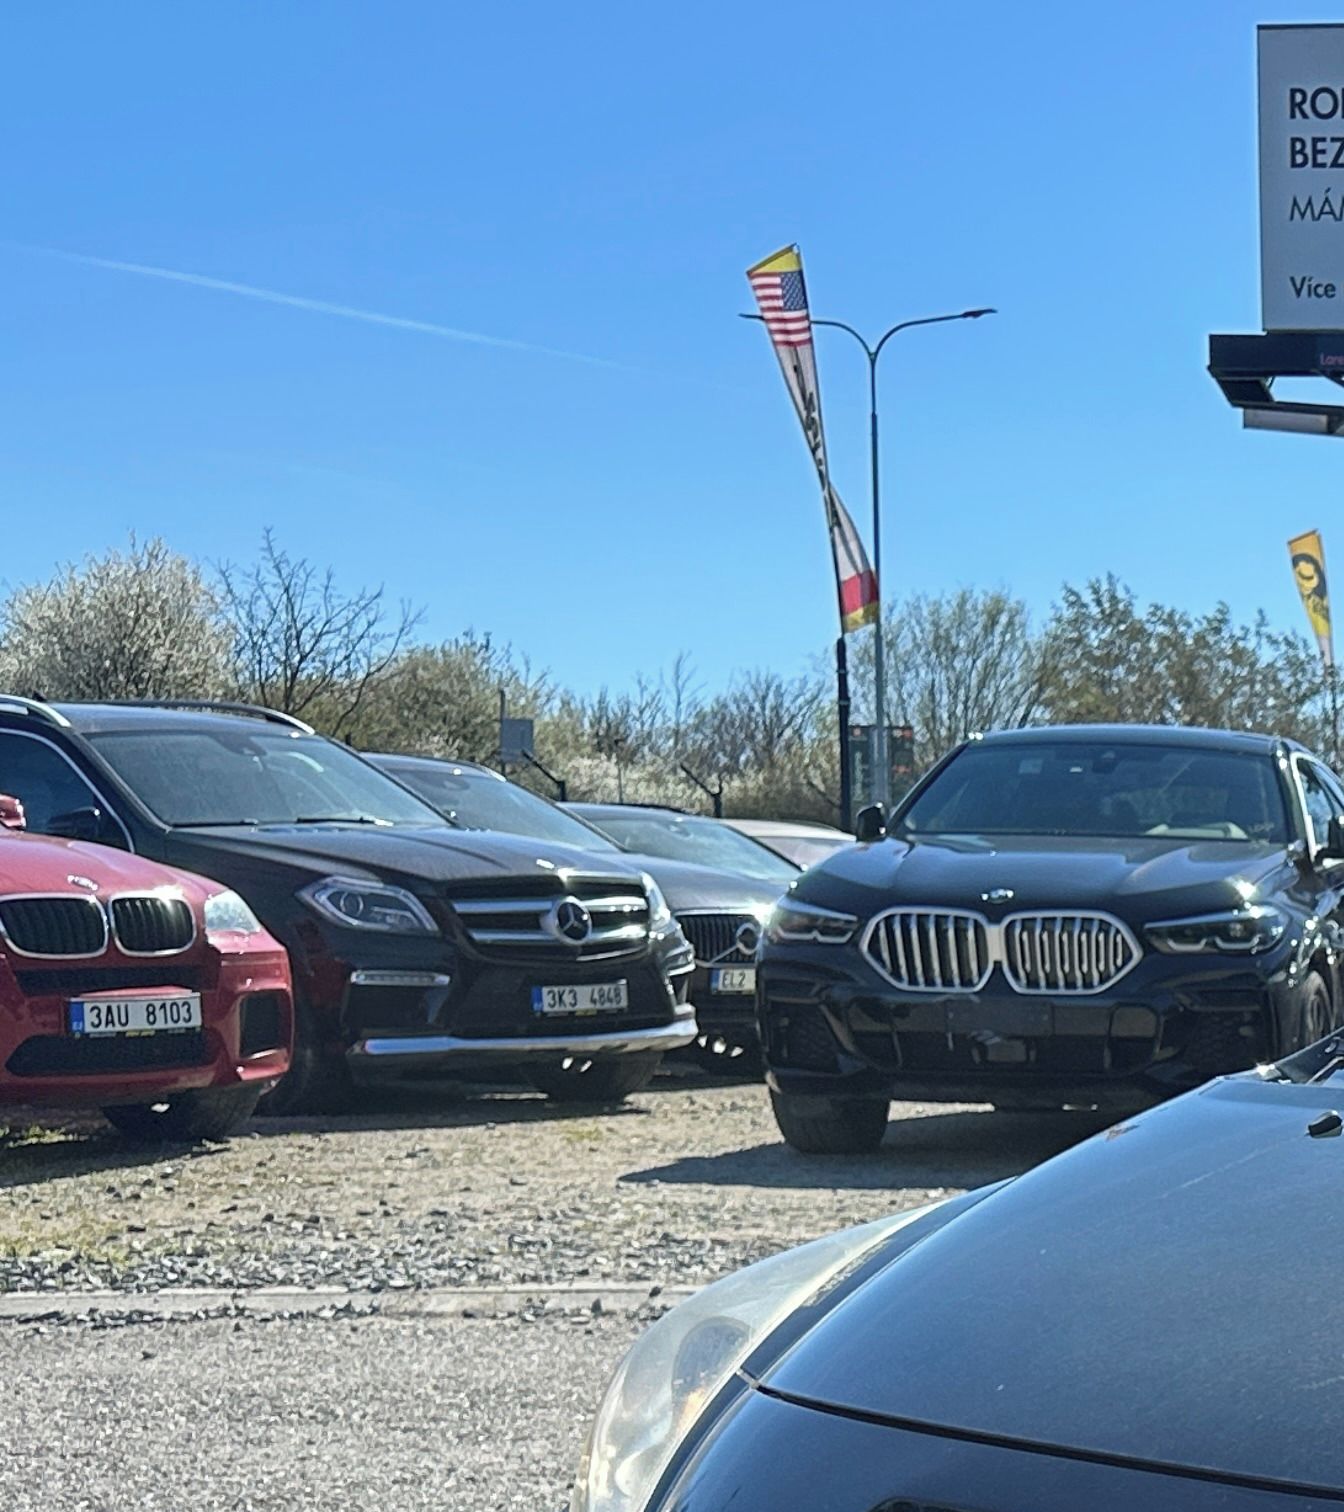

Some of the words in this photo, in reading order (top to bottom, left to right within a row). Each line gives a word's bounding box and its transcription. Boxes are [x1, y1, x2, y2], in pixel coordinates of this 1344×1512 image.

[1289, 275, 1337, 299] Více
[547, 988, 579, 1009] 3K3
[89, 1003, 130, 1029] 3AU
[145, 1001, 193, 1026] 8103
